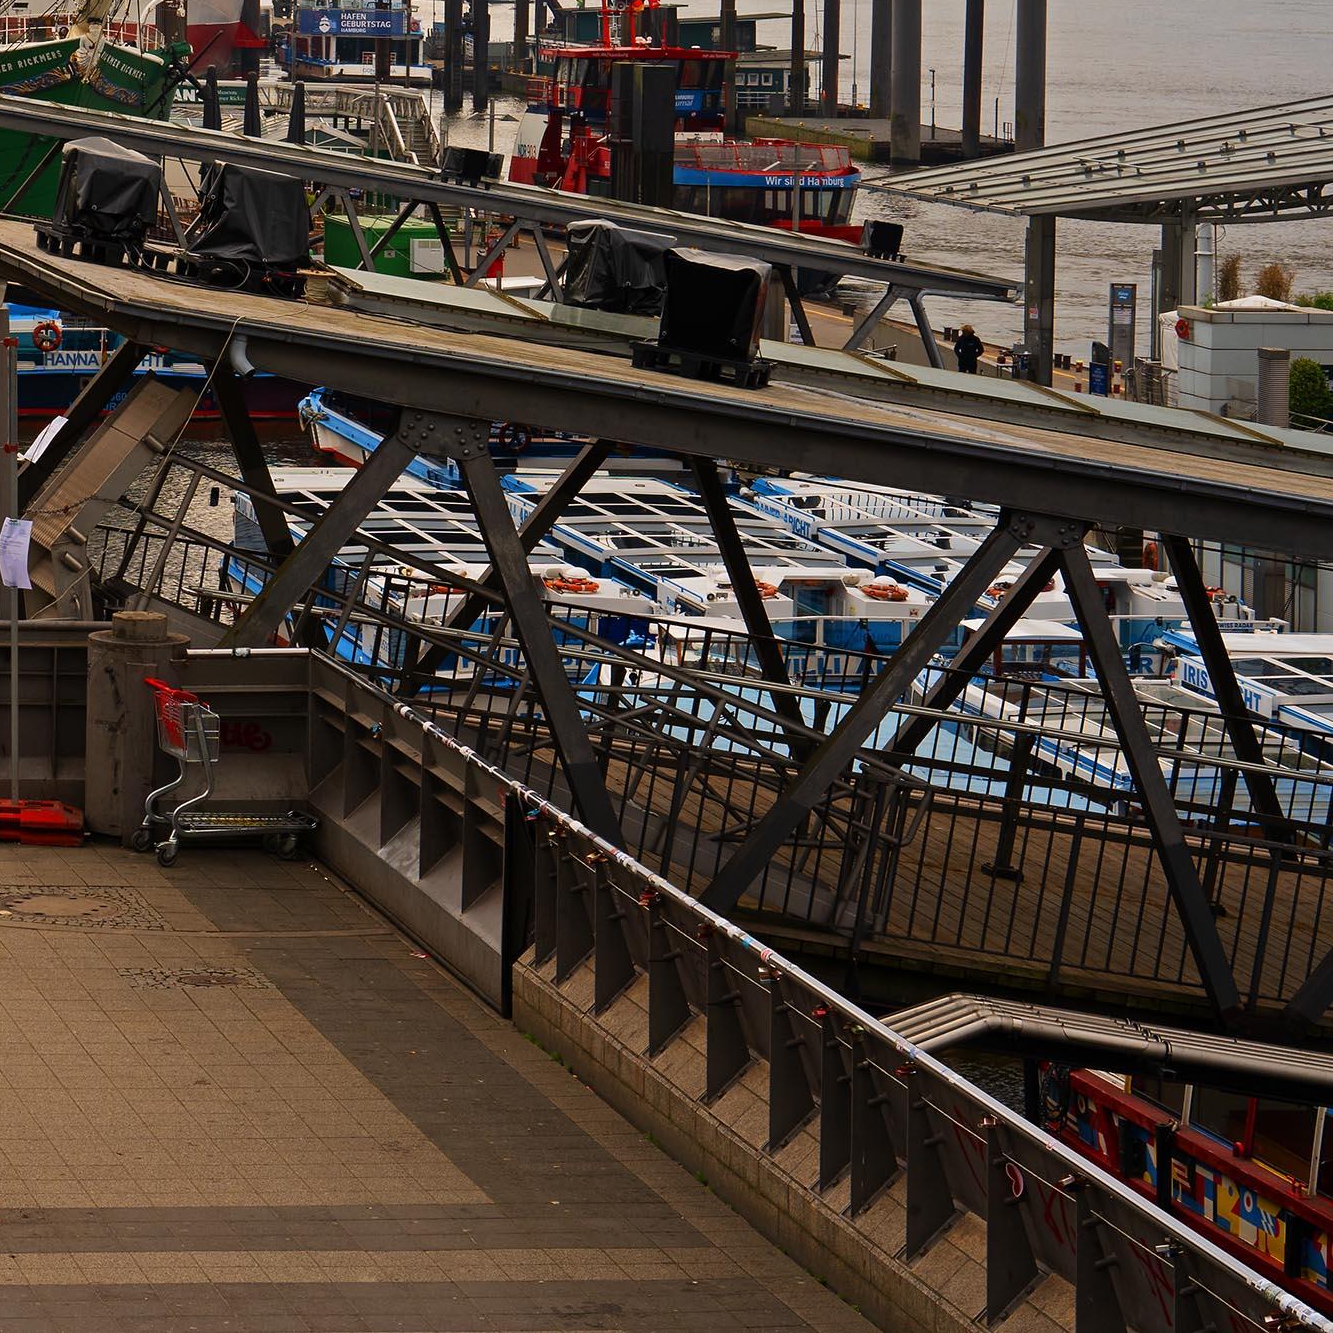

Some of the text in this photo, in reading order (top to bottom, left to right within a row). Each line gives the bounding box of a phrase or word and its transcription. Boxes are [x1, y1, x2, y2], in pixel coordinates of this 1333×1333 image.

[341, 20, 391, 28] GEBURTSTAG
[18, 49, 62, 69] RICKMERS
[765, 176, 782, 186] Wir
[44, 353, 99, 366] HANNA
[1183, 665, 1208, 690] IRIS
